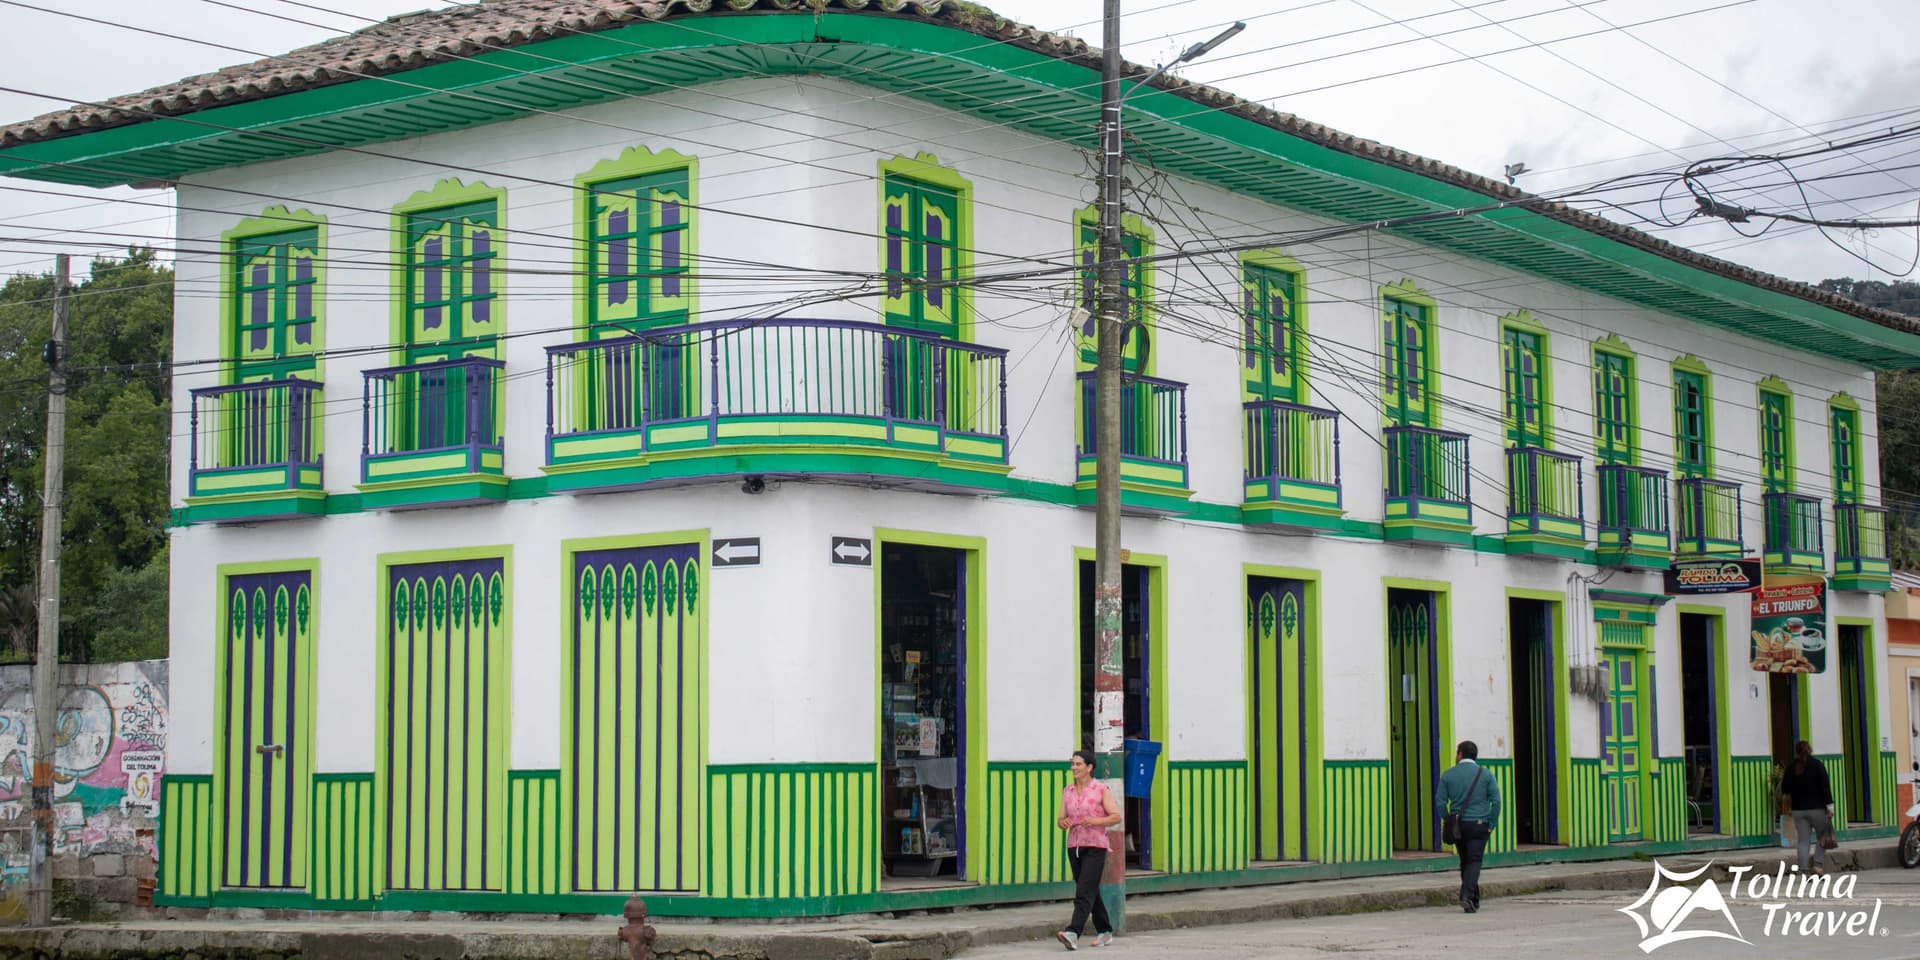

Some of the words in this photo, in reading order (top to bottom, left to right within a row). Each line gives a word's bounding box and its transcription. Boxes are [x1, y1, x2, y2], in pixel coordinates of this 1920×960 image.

[1680, 575, 1747, 583] TOLIMA
[1759, 602, 1770, 614] EL
[1772, 599, 1813, 613] TRIUNFO
